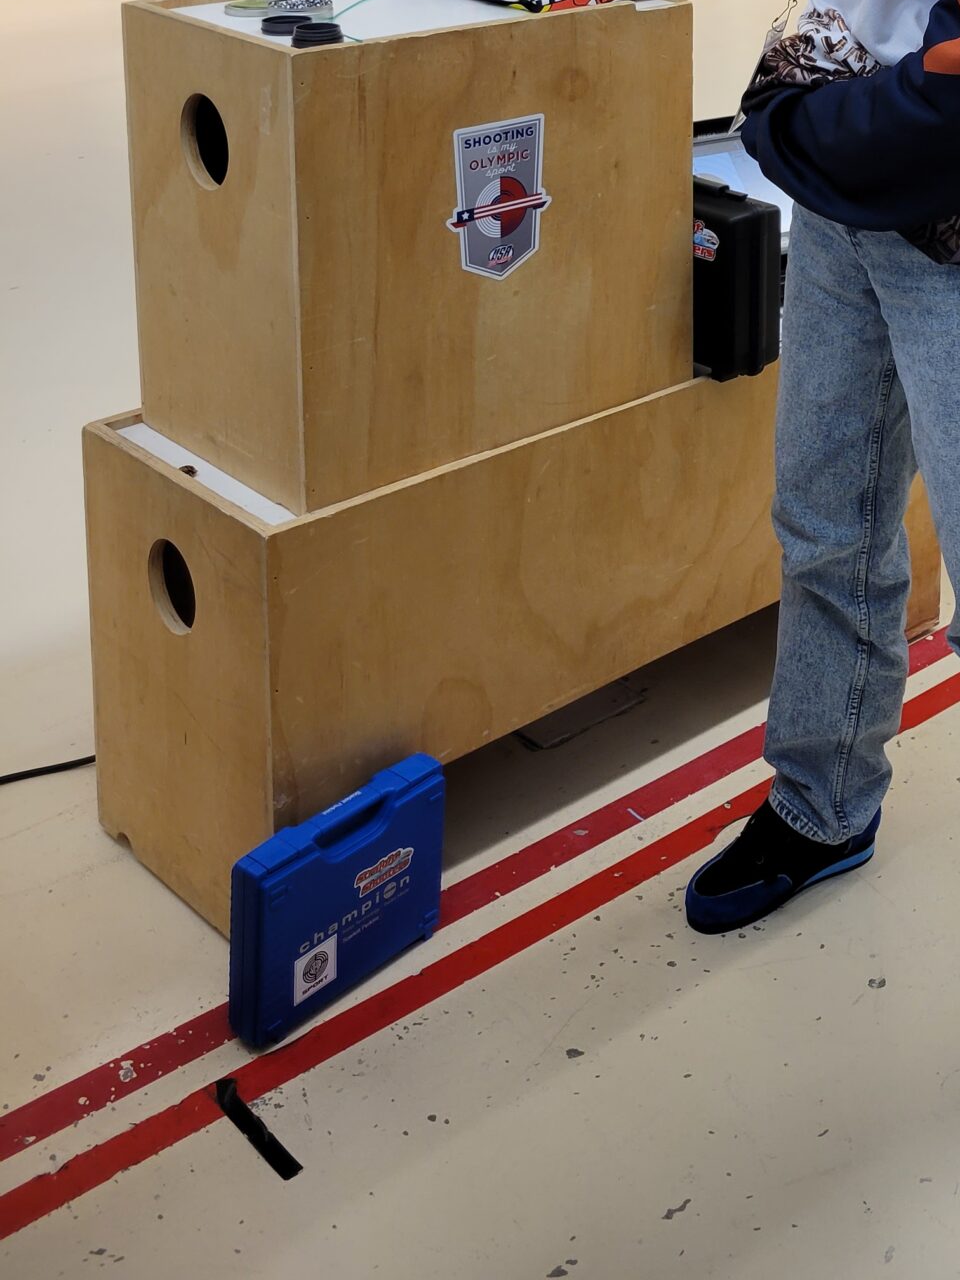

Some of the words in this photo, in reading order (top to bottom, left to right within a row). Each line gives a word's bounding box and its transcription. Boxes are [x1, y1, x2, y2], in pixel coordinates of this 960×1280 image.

[464, 126, 535, 150] SHOOTING
[487, 145, 498, 155] is
[500, 141, 518, 152] my
[469, 149, 530, 171] OLYMPIC
[484, 163, 517, 178] sport
[491, 245, 513, 262] USA
